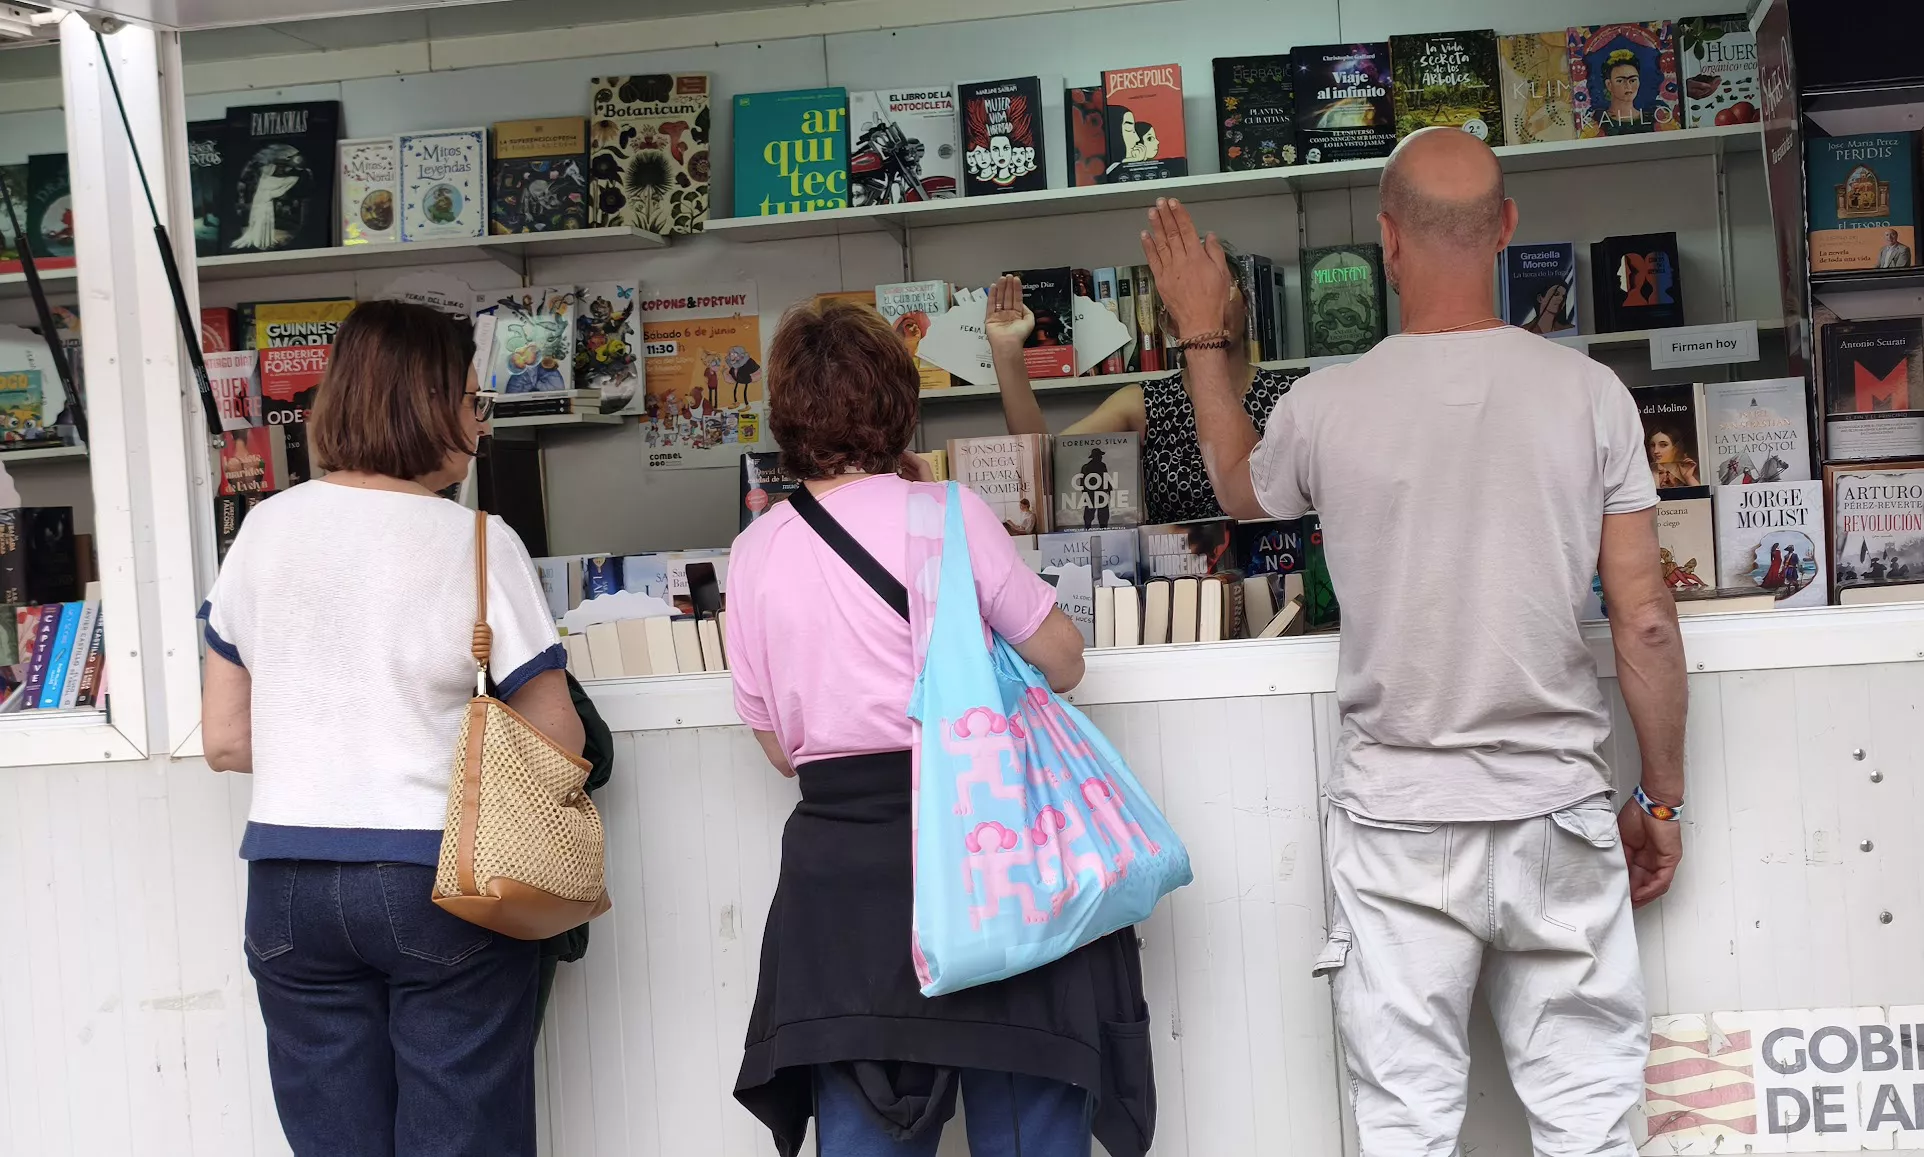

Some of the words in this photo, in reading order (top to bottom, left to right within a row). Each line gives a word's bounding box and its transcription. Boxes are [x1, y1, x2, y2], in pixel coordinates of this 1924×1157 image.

[1707, 41, 1757, 62] HUER
[1332, 71, 1368, 87] Viaje
[889, 94, 900, 102] EL
[901, 92, 926, 101] LIBRO
[928, 92, 939, 100] DE
[1317, 87, 1331, 99] al
[1333, 84, 1386, 98] infinito
[1513, 79, 1571, 100] KLIM
[603, 103, 696, 118] Botanicum
[889, 100, 952, 112] MOTOCICLETA
[984, 97, 1010, 113] MUJER
[1250, 107, 1284, 116] PLANTAS
[251, 110, 309, 136] FANTASMAS
[801, 107, 846, 134] ar
[989, 111, 1007, 124] VIDA
[1244, 115, 1290, 124] CURATIVAS
[1580, 106, 1673, 129] KAHLO
[422, 144, 462, 162] Mitos
[417, 162, 472, 181] Leyendas
[787, 163, 846, 196] tec
[1520, 251, 1560, 260] Graziella
[1522, 259, 1558, 269] Moreno
[912, 293, 921, 302] DE
[923, 292, 935, 301] LAS
[644, 328, 682, 341] Sábado
[684, 327, 691, 337] 6
[695, 326, 706, 337] de
[709, 325, 736, 339] junio
[646, 344, 674, 355] 11:30
[678, 343, 685, 352] h
[1671, 340, 1713, 353] Firman
[1716, 338, 1737, 350] hoy
[1840, 339, 1875, 350] Antonio
[1876, 337, 1906, 347] Scurati
[268, 349, 325, 360] FREDERICK
[1854, 357, 1909, 413] M
[1643, 404, 1655, 414] del
[1657, 403, 1688, 413] Molino
[1062, 439, 1102, 448] LORENZO
[1714, 435, 1729, 444] LA
[1732, 429, 1798, 442] VENGANZA
[961, 441, 1025, 456] SONSOLES
[1718, 445, 1739, 455] DEL
[1741, 440, 1796, 454] APÓSTOL
[972, 455, 1016, 468] ÓNEGA
[980, 481, 1031, 495] NOMBRE
[1071, 471, 1119, 491] CON
[1061, 489, 1129, 510] NADIE
[1739, 488, 1803, 510] JORGE
[1844, 485, 1922, 500] ARTURO
[1656, 507, 1688, 516] Toscana
[1844, 500, 1922, 510] PÉREZ-REVERTE
[1662, 520, 1680, 528] ciego
[1735, 508, 1808, 529] MOLIST
[1843, 511, 1922, 532] REVOLUCIÓN
[1063, 542, 1106, 554] MIKL
[1050, 555, 1120, 567] SANTIGO
[1265, 553, 1295, 571] NO
[1074, 604, 1093, 616] DEL
[31, 614, 54, 683] CAPTIVE
[1766, 1085, 1847, 1135] DE
